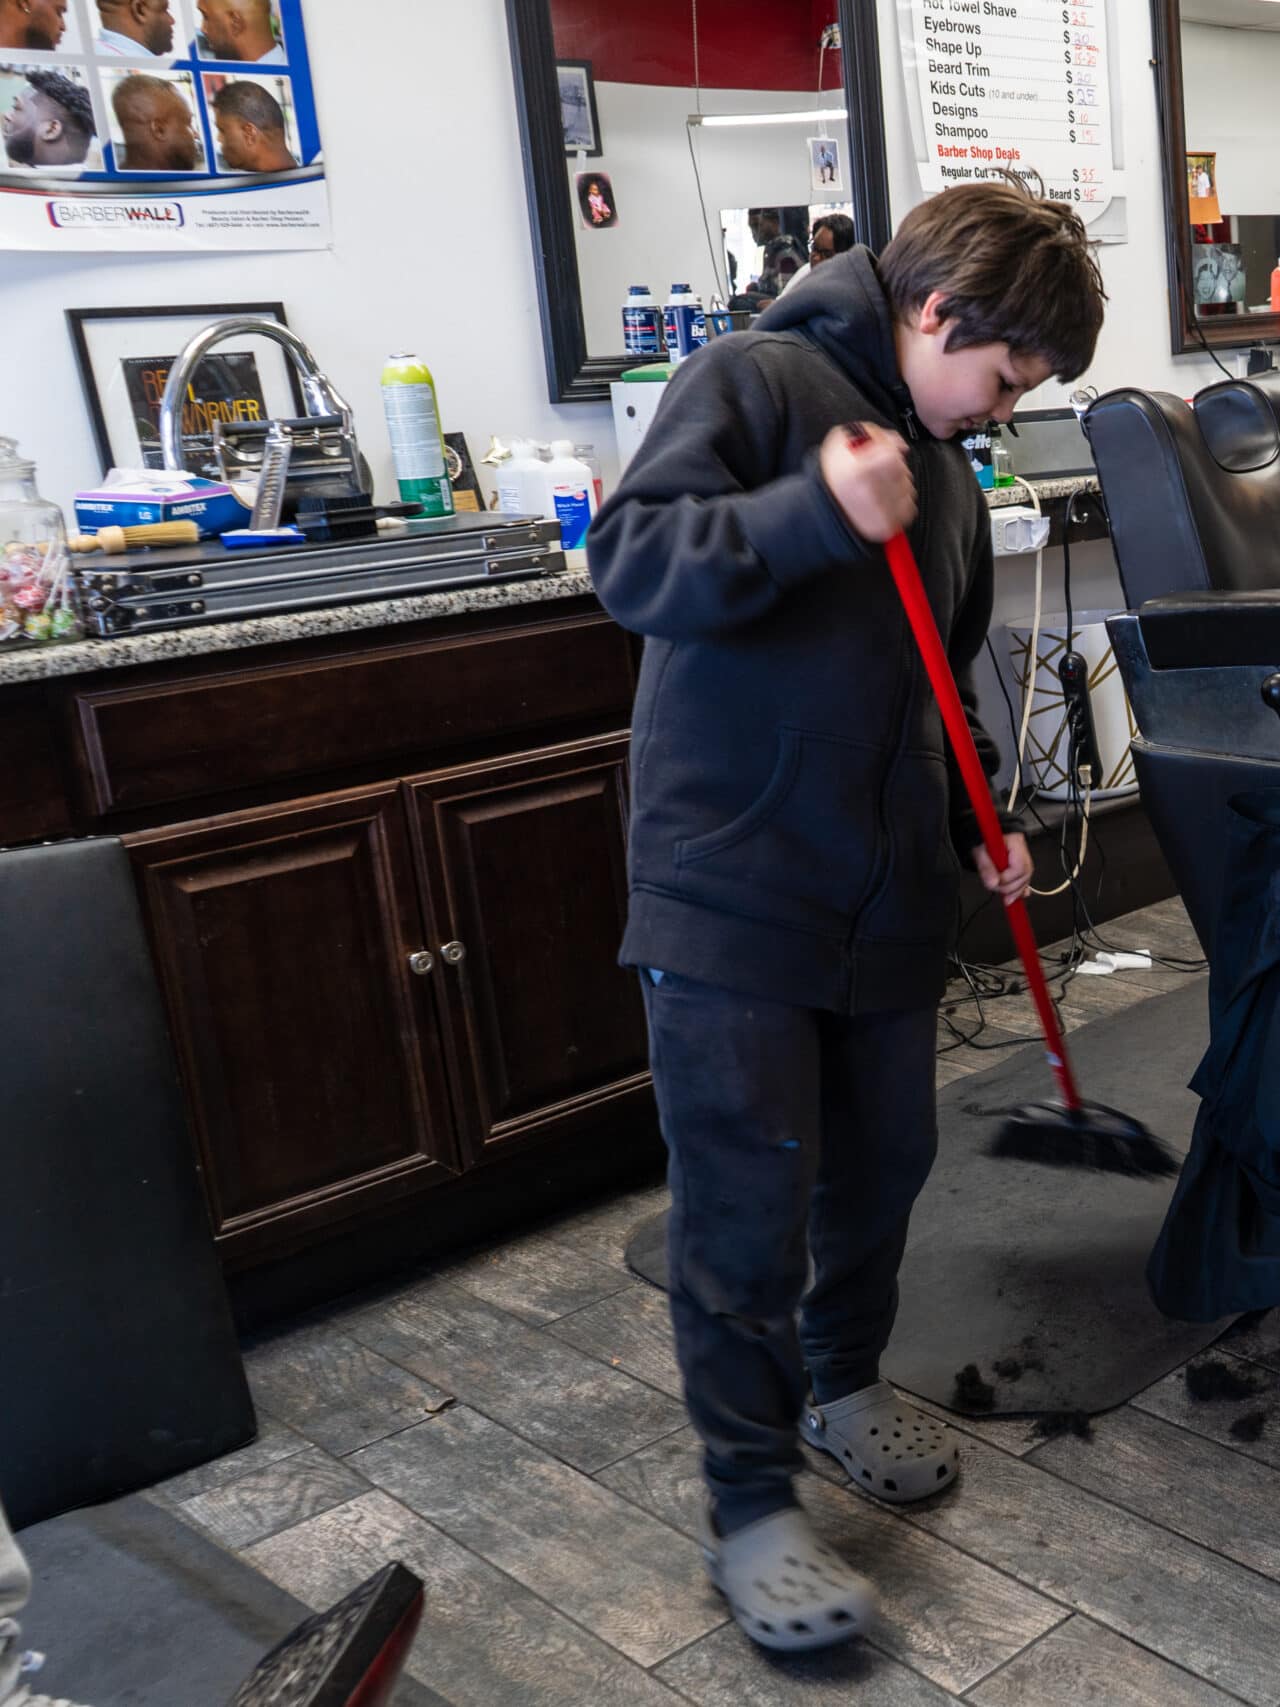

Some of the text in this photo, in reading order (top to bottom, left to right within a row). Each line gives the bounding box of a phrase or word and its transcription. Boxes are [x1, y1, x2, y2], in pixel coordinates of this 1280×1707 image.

[948, 0, 980, 14] Towel
[983, 1, 1017, 18] Shave
[924, 16, 981, 35] Eyebrows
[925, 38, 963, 56] Shape
[965, 42, 982, 58] Up
[928, 59, 963, 75] Beard
[965, 62, 991, 77] Trim
[930, 80, 956, 95] Kids
[959, 82, 986, 98] Cuts
[1001, 90, 1015, 100] and
[932, 102, 978, 120] Designs
[935, 122, 988, 140] Shampoo
[937, 144, 1020, 161] Barber Shop Deals
[941, 165, 972, 180] Regular
[974, 167, 989, 178] Cut
[1049, 188, 1072, 200] Beard
[59, 206, 177, 221] BARBERWALL
